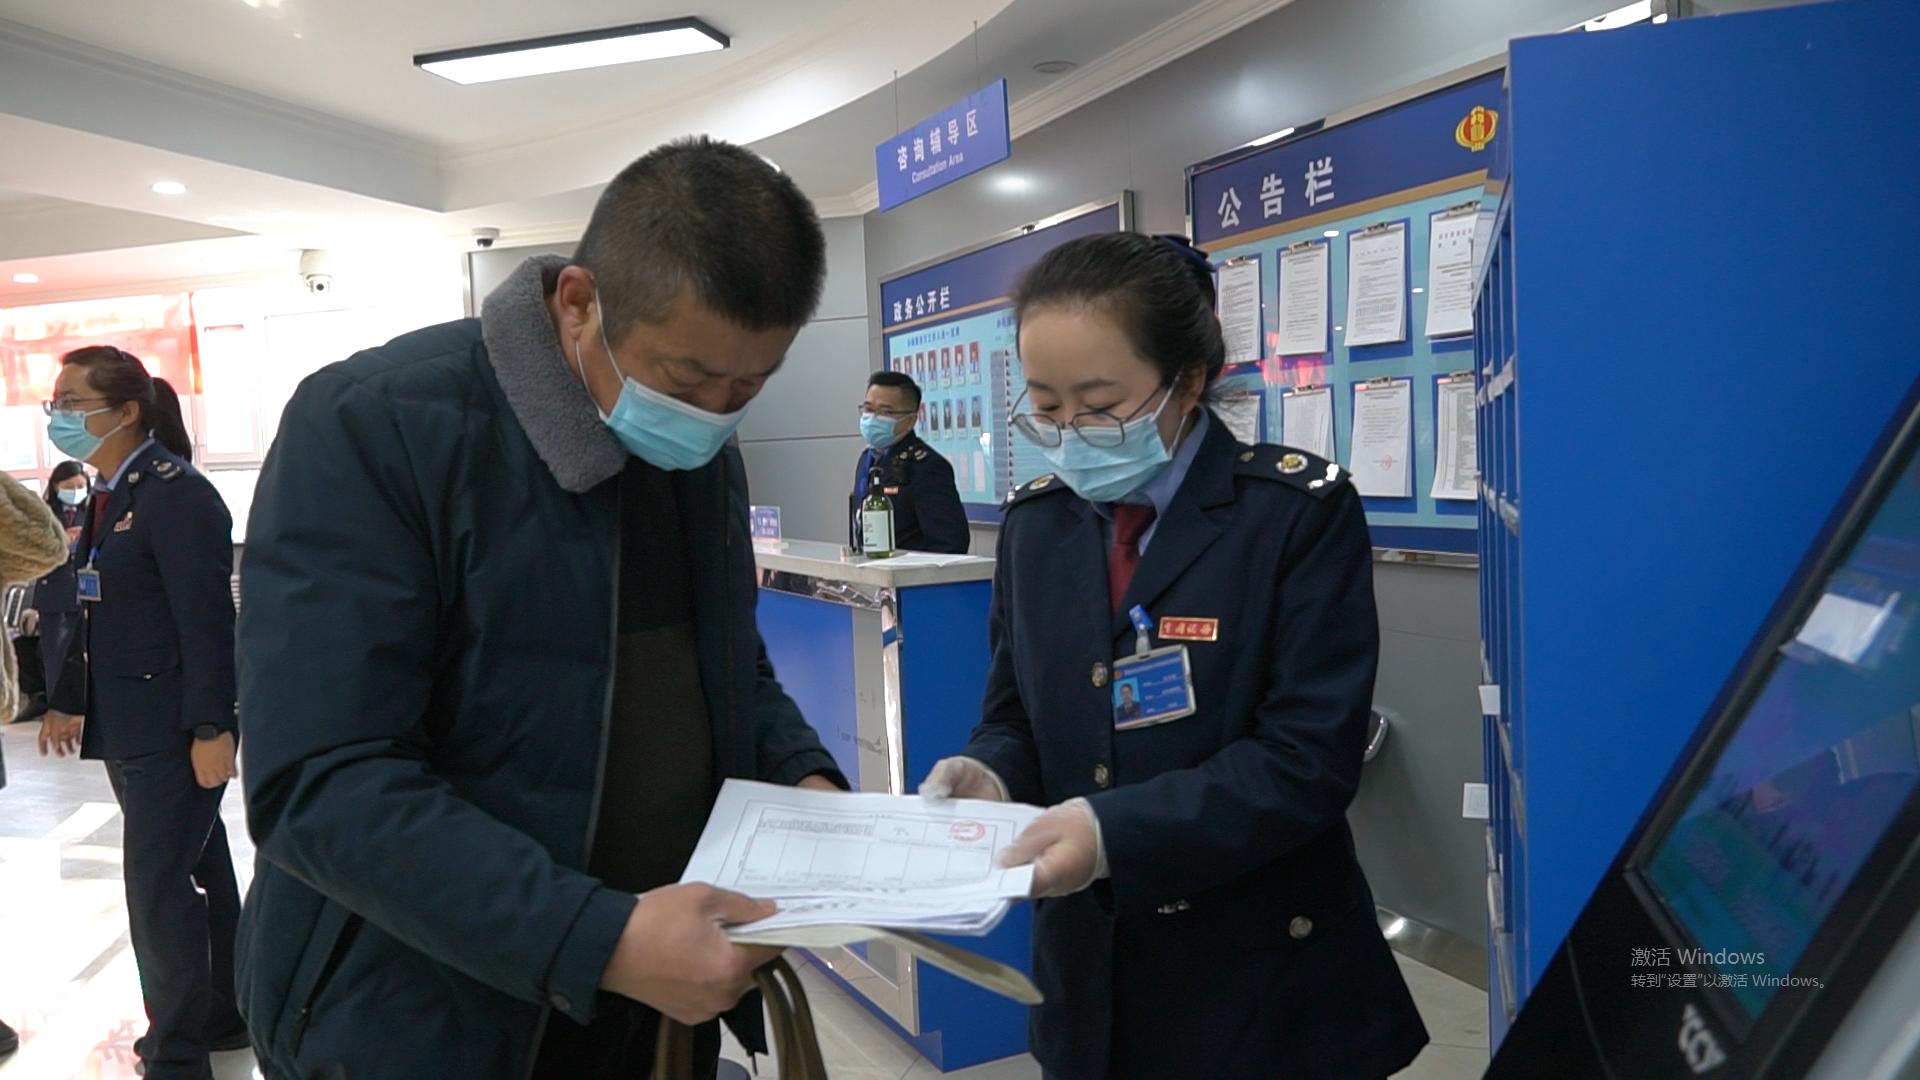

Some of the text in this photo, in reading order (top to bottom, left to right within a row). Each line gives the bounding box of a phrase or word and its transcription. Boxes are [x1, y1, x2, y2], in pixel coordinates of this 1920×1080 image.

[897, 109, 978, 171] 咨询辅导区
[912, 152, 964, 184] Consultation Area
[1218, 156, 1335, 229] 公告栏
[893, 286, 951, 322] 政务公开栏
